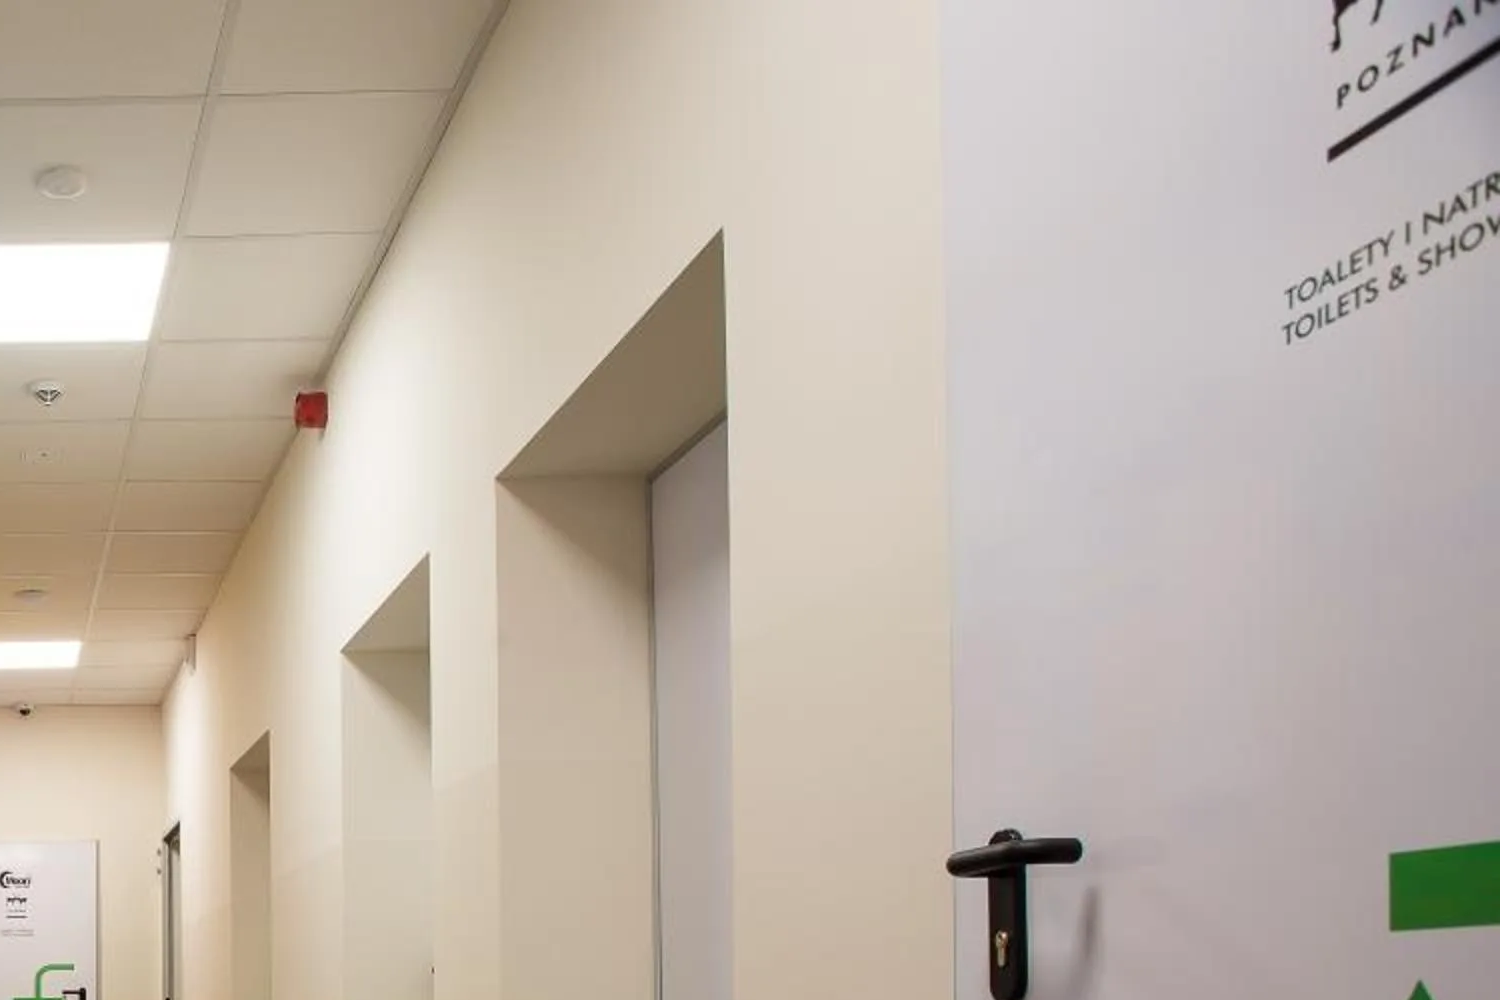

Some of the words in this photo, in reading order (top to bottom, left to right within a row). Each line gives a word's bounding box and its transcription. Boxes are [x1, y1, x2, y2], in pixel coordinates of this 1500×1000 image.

[1282, 278, 1380, 346] TOILETS
[1387, 265, 1408, 291] &
[1284, 230, 1394, 310] TOALETY
[1404, 221, 1412, 245] I
